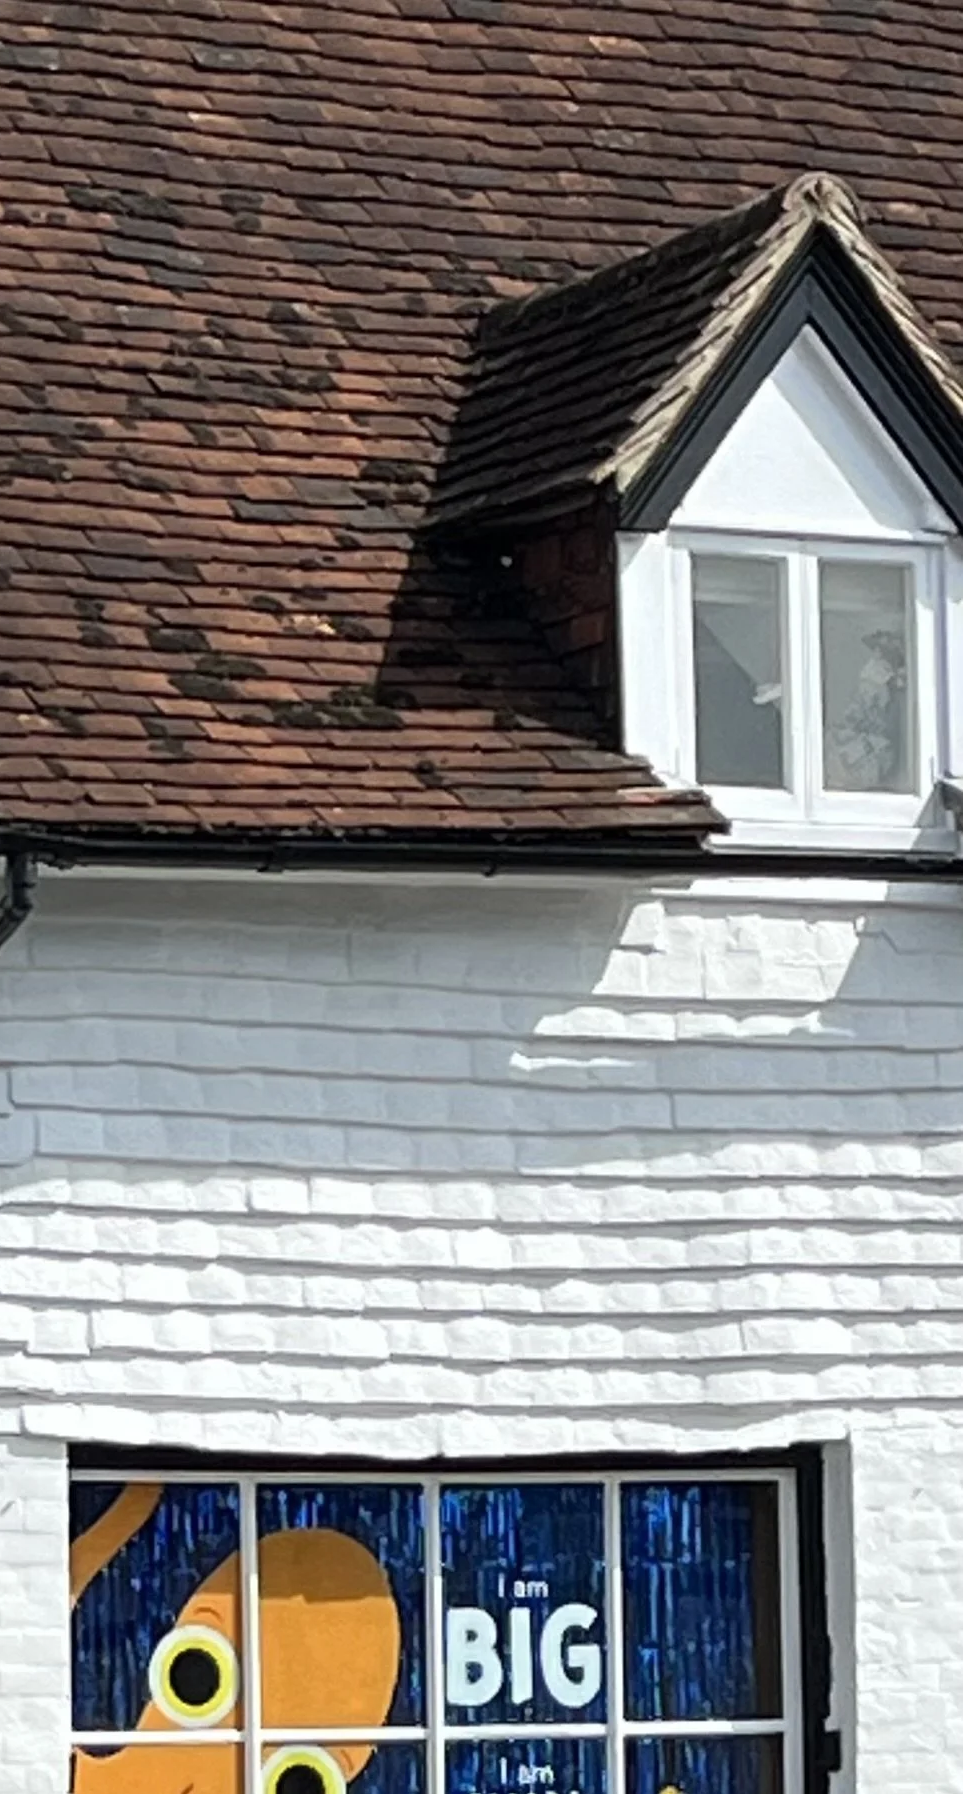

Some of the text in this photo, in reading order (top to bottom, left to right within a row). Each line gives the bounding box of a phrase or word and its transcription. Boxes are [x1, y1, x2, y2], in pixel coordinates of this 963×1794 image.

[498, 1572, 549, 1599] I am
[445, 1602, 602, 1709] BIG
[500, 1756, 555, 1785] I am
